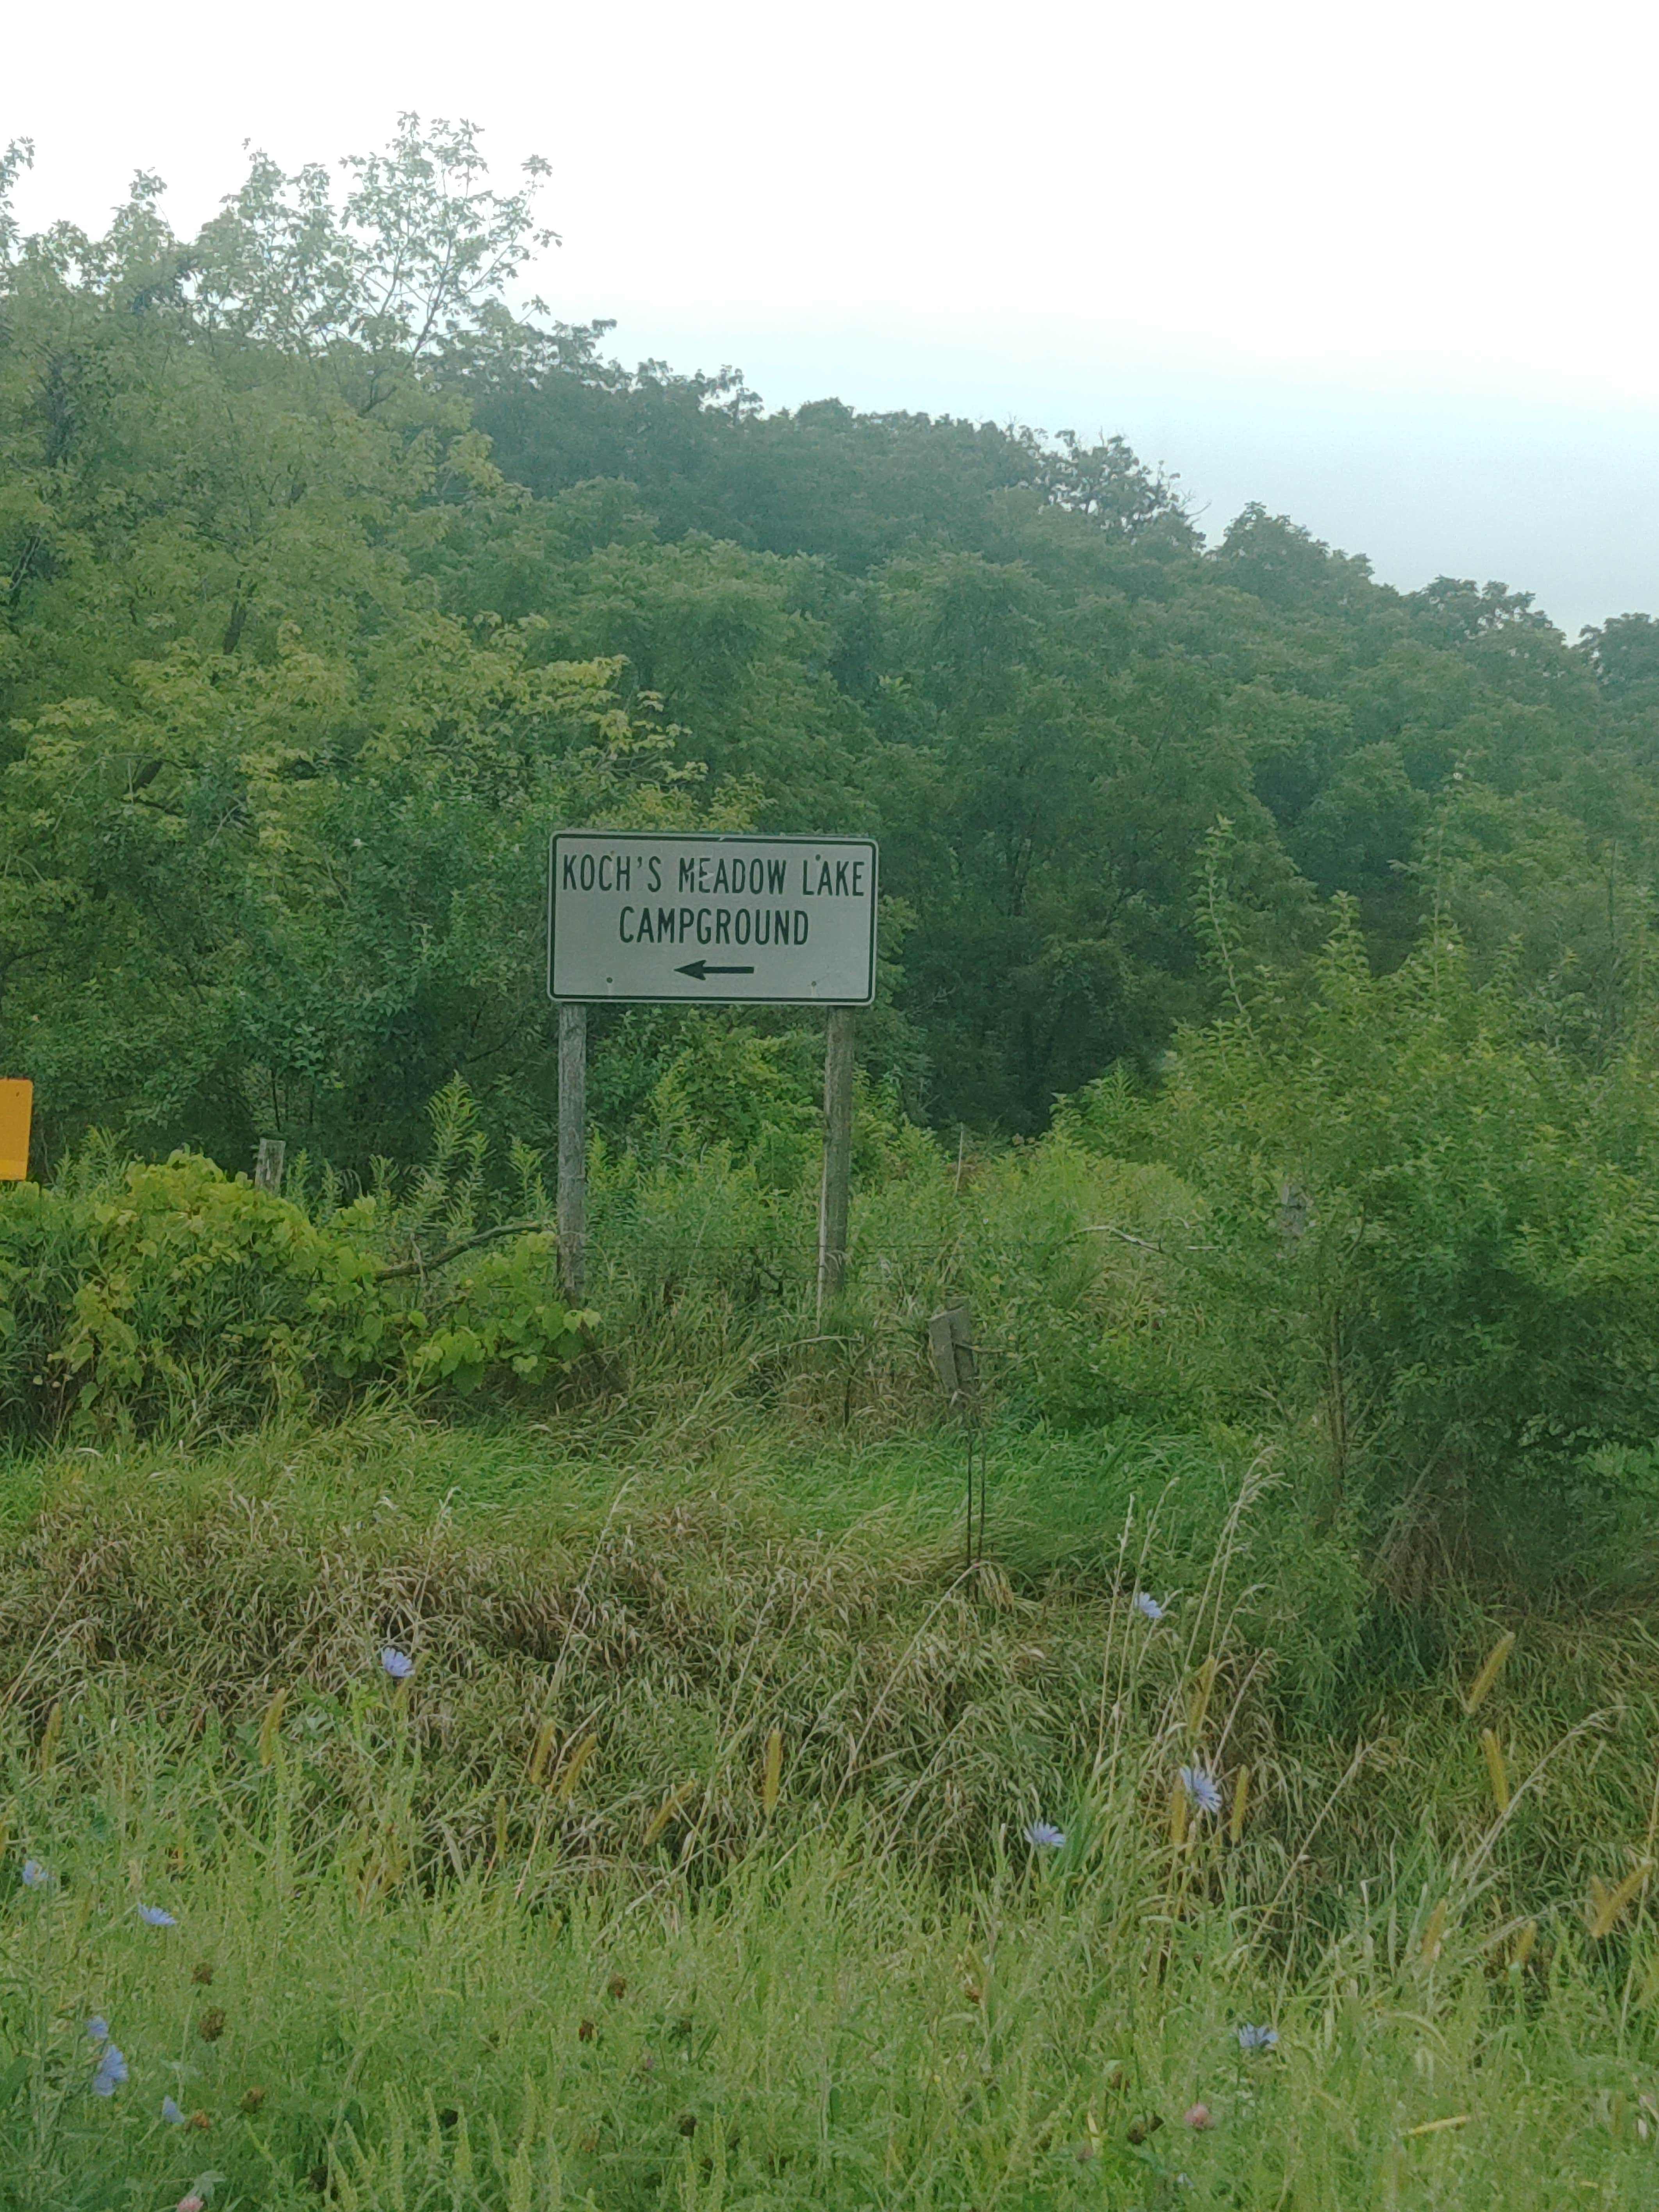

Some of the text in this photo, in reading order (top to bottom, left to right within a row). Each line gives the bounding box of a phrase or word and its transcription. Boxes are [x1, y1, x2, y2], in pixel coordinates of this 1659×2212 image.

[562, 854, 865, 897] KOCH'S MEADOW LAKE
[619, 906, 809, 945] CAMPGROUND
